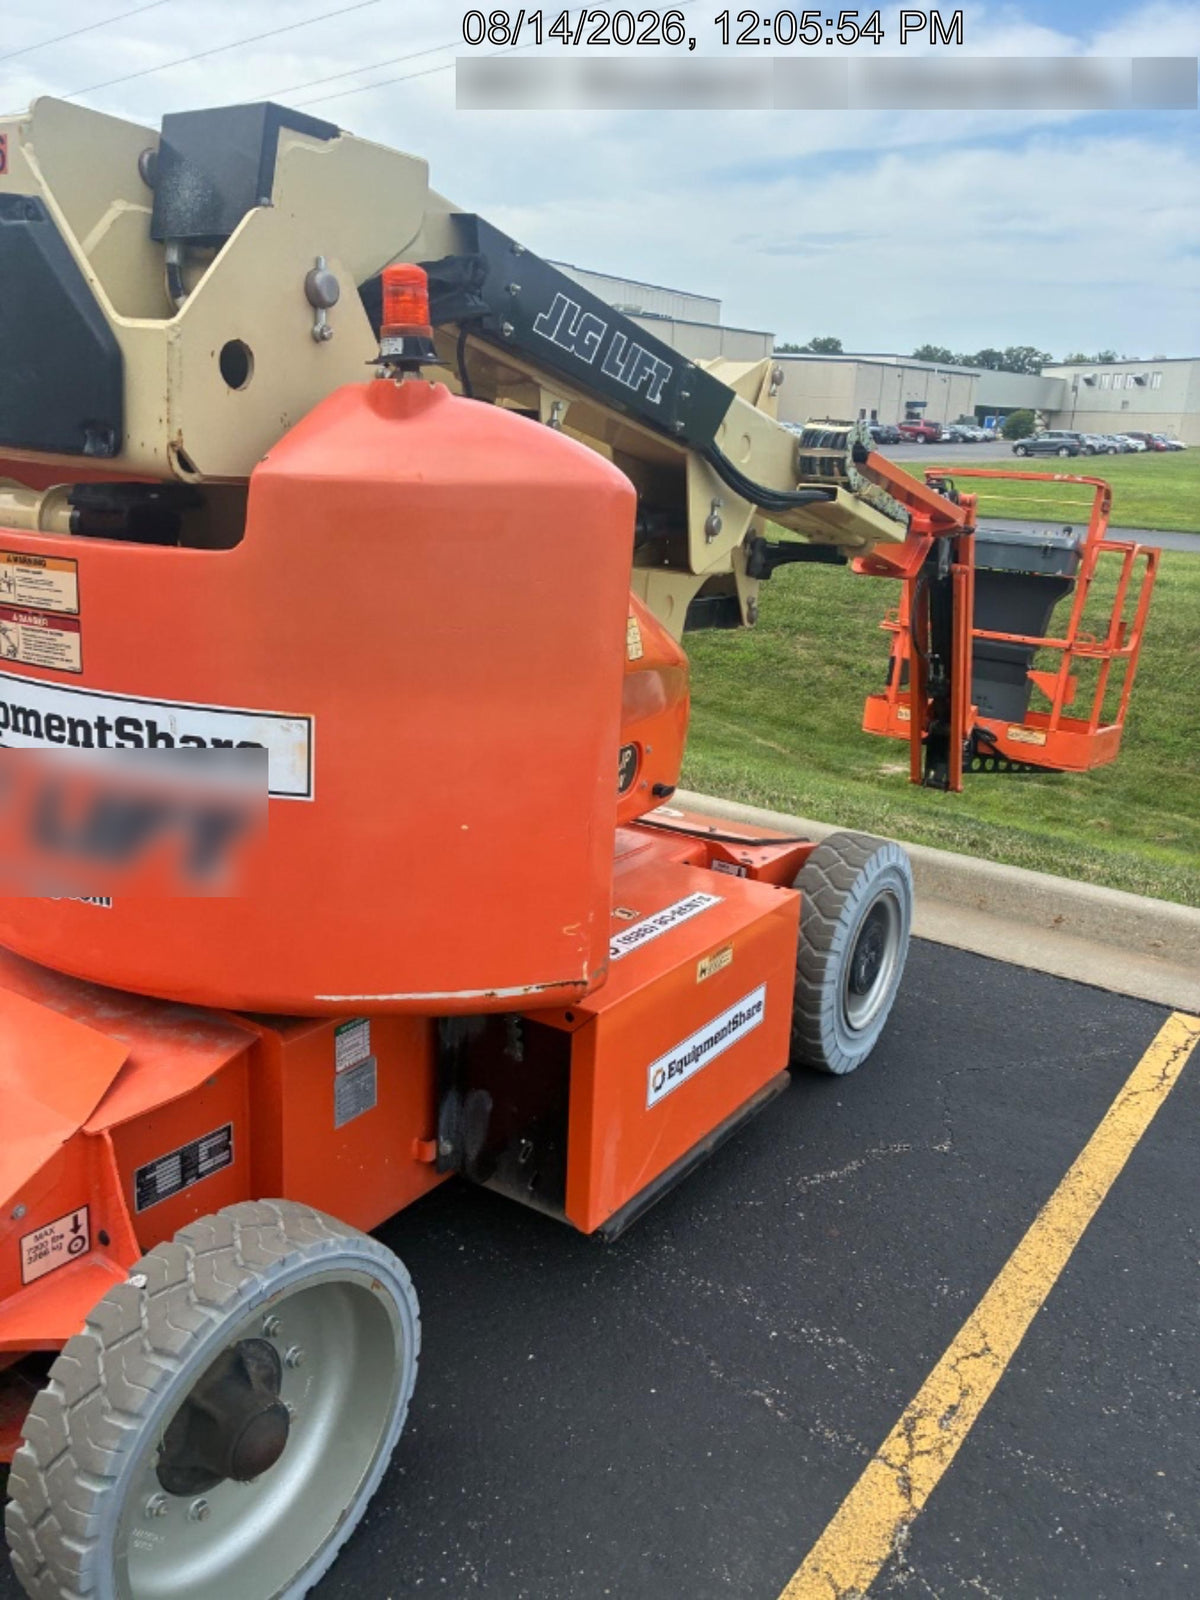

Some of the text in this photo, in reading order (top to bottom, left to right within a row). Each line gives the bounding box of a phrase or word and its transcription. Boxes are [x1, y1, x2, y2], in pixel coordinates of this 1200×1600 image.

[533, 292, 673, 405] JLG LIFT
[0, 700, 265, 748] mentSh
[666, 1000, 763, 1080] EquipmentShare
[34, 1226, 55, 1242] MAX
